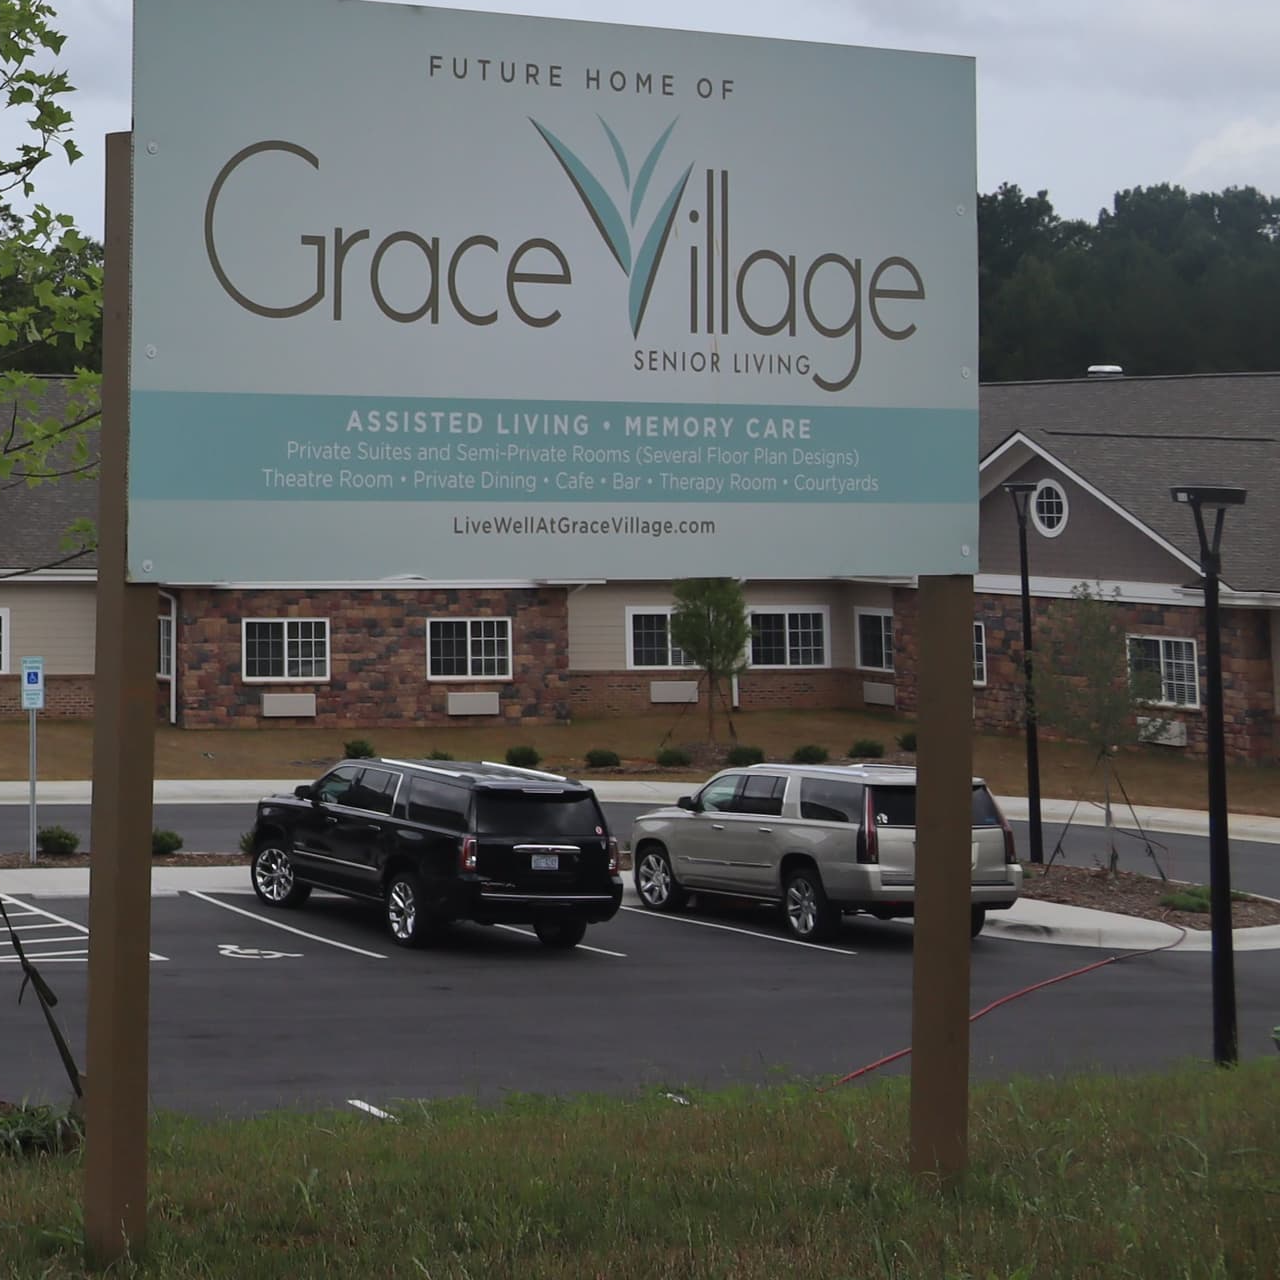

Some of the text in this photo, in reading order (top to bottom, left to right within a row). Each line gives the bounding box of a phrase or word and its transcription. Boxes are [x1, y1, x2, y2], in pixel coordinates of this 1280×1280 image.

[429, 55, 735, 100] FUTURE HOME OF
[204, 114, 926, 393] Grace Village
[633, 349, 811, 376] SENIOR LIVING
[345, 410, 812, 439] ASSISTED LIVING MEMORY CARE
[287, 440, 860, 469] Private Suites and Semi-Private Rooms (Several Floor Plan Designs)
[262, 468, 880, 495] Theatre Room Private Dining Cafe Bar Therapy Room Courtyards
[453, 515, 716, 538] LiveWellAtGraceVillage.com
